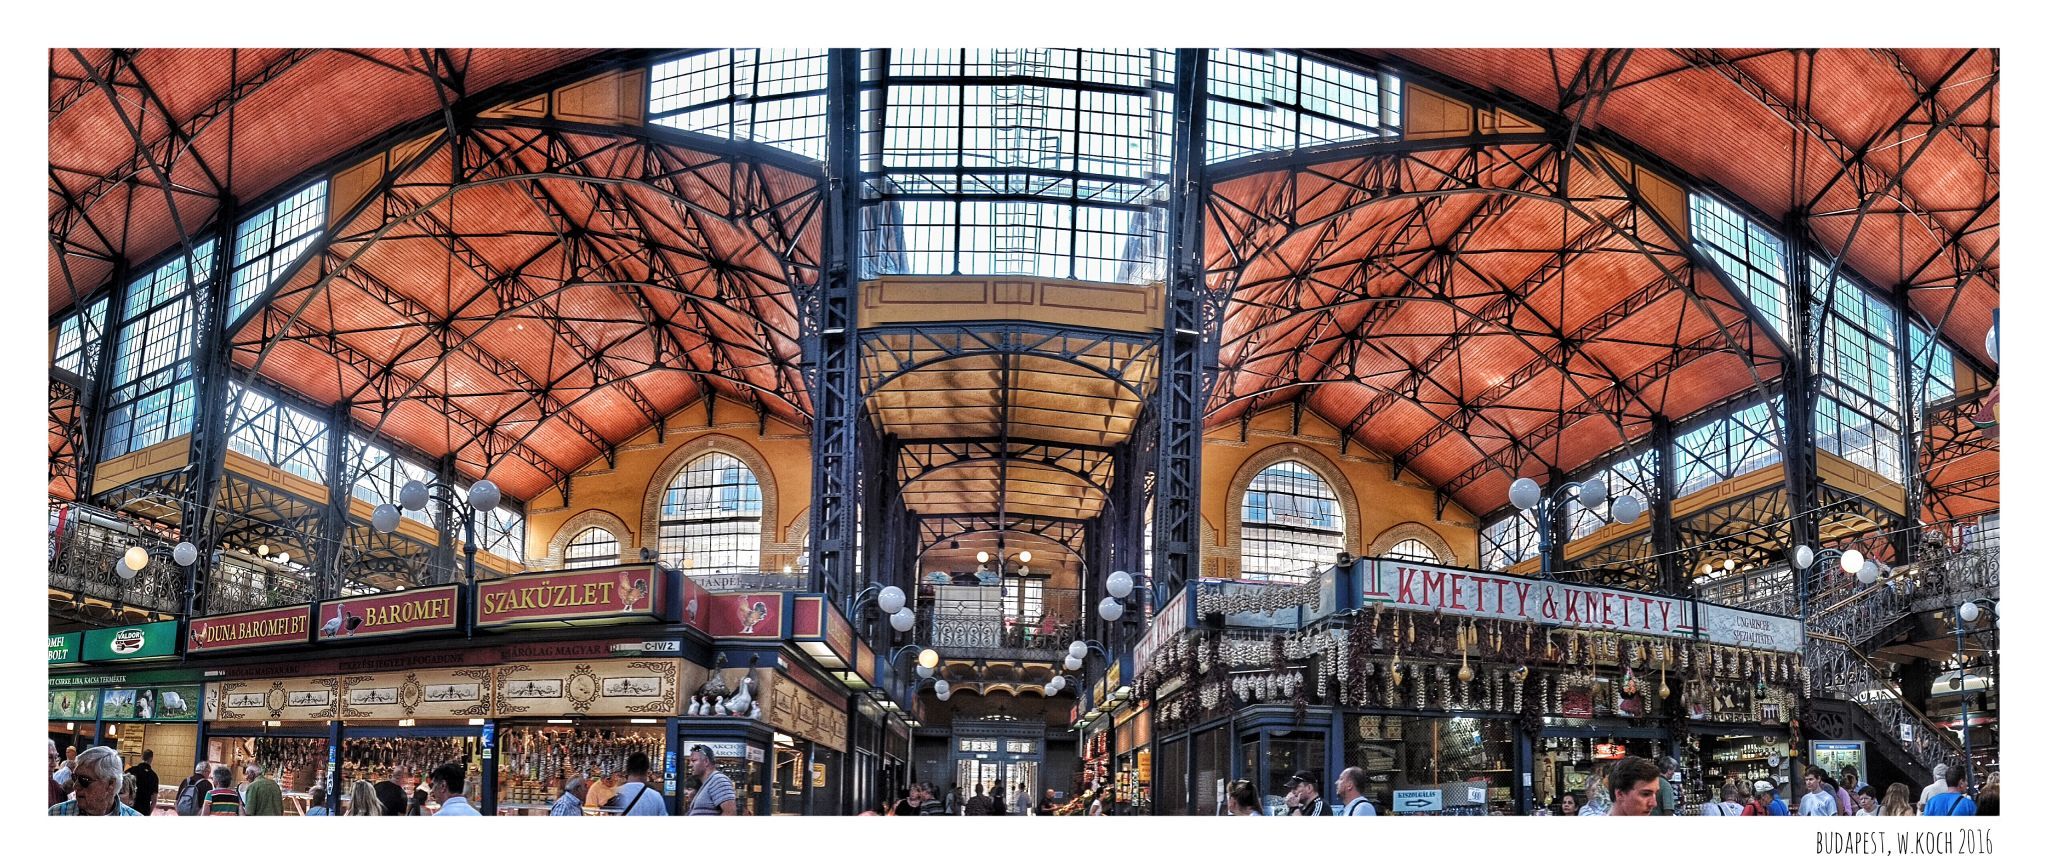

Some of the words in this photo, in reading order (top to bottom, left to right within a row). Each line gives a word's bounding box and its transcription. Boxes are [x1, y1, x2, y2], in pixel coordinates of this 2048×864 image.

[483, 581, 614, 615] SZAKÜZLET
[1396, 567, 1532, 616] KMETTY
[1542, 585, 1559, 619] &
[365, 598, 450, 627] BAROMFI
[207, 624, 237, 643] DUNA
[238, 617, 290, 639] BAROMFI
[290, 615, 307, 634] BT
[48, 649, 68, 660] BOLT
